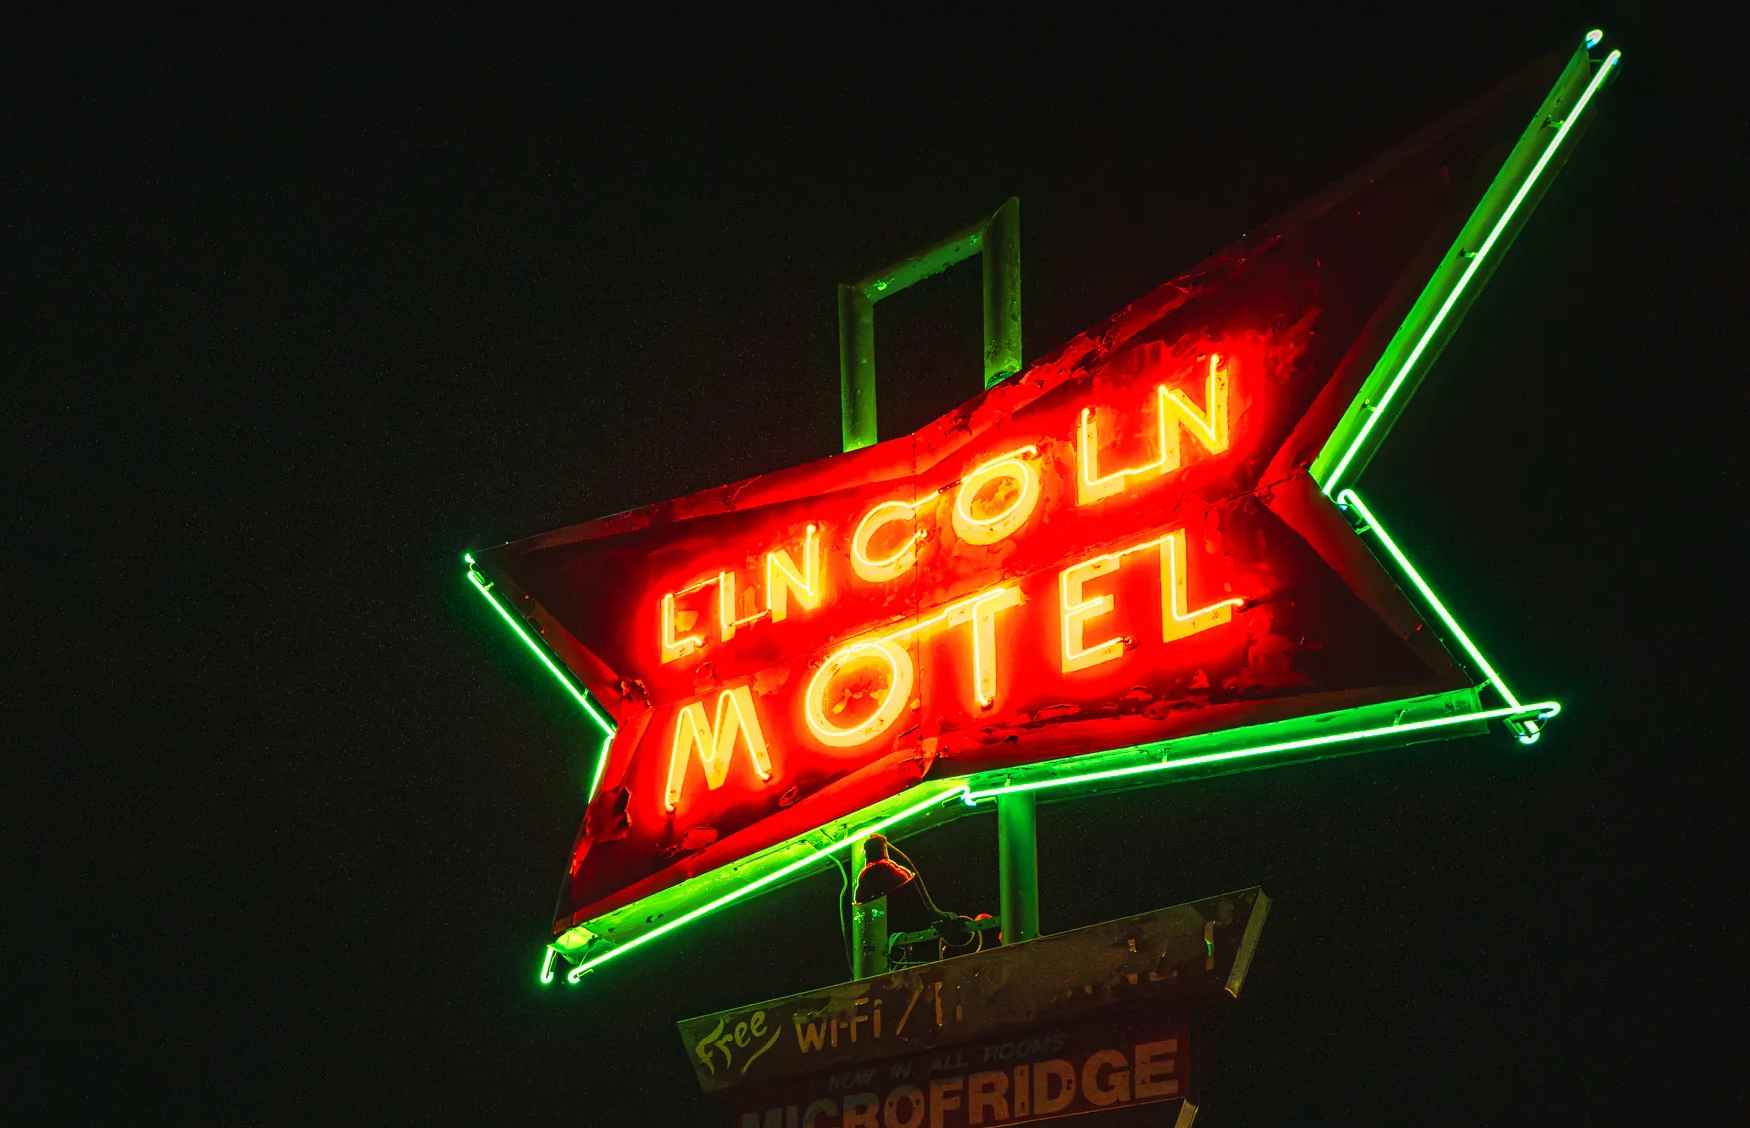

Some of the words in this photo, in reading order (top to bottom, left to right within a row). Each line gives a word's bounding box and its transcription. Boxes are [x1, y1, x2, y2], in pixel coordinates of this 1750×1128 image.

[661, 352, 1228, 665] LINCOLN
[665, 528, 1244, 814] MOTEL
[695, 1010, 768, 1075] Free
[829, 1068, 875, 1091] NOW
[890, 1061, 914, 1079] IN
[928, 1052, 968, 1074] ALL
[983, 1033, 1066, 1063] ROOMS
